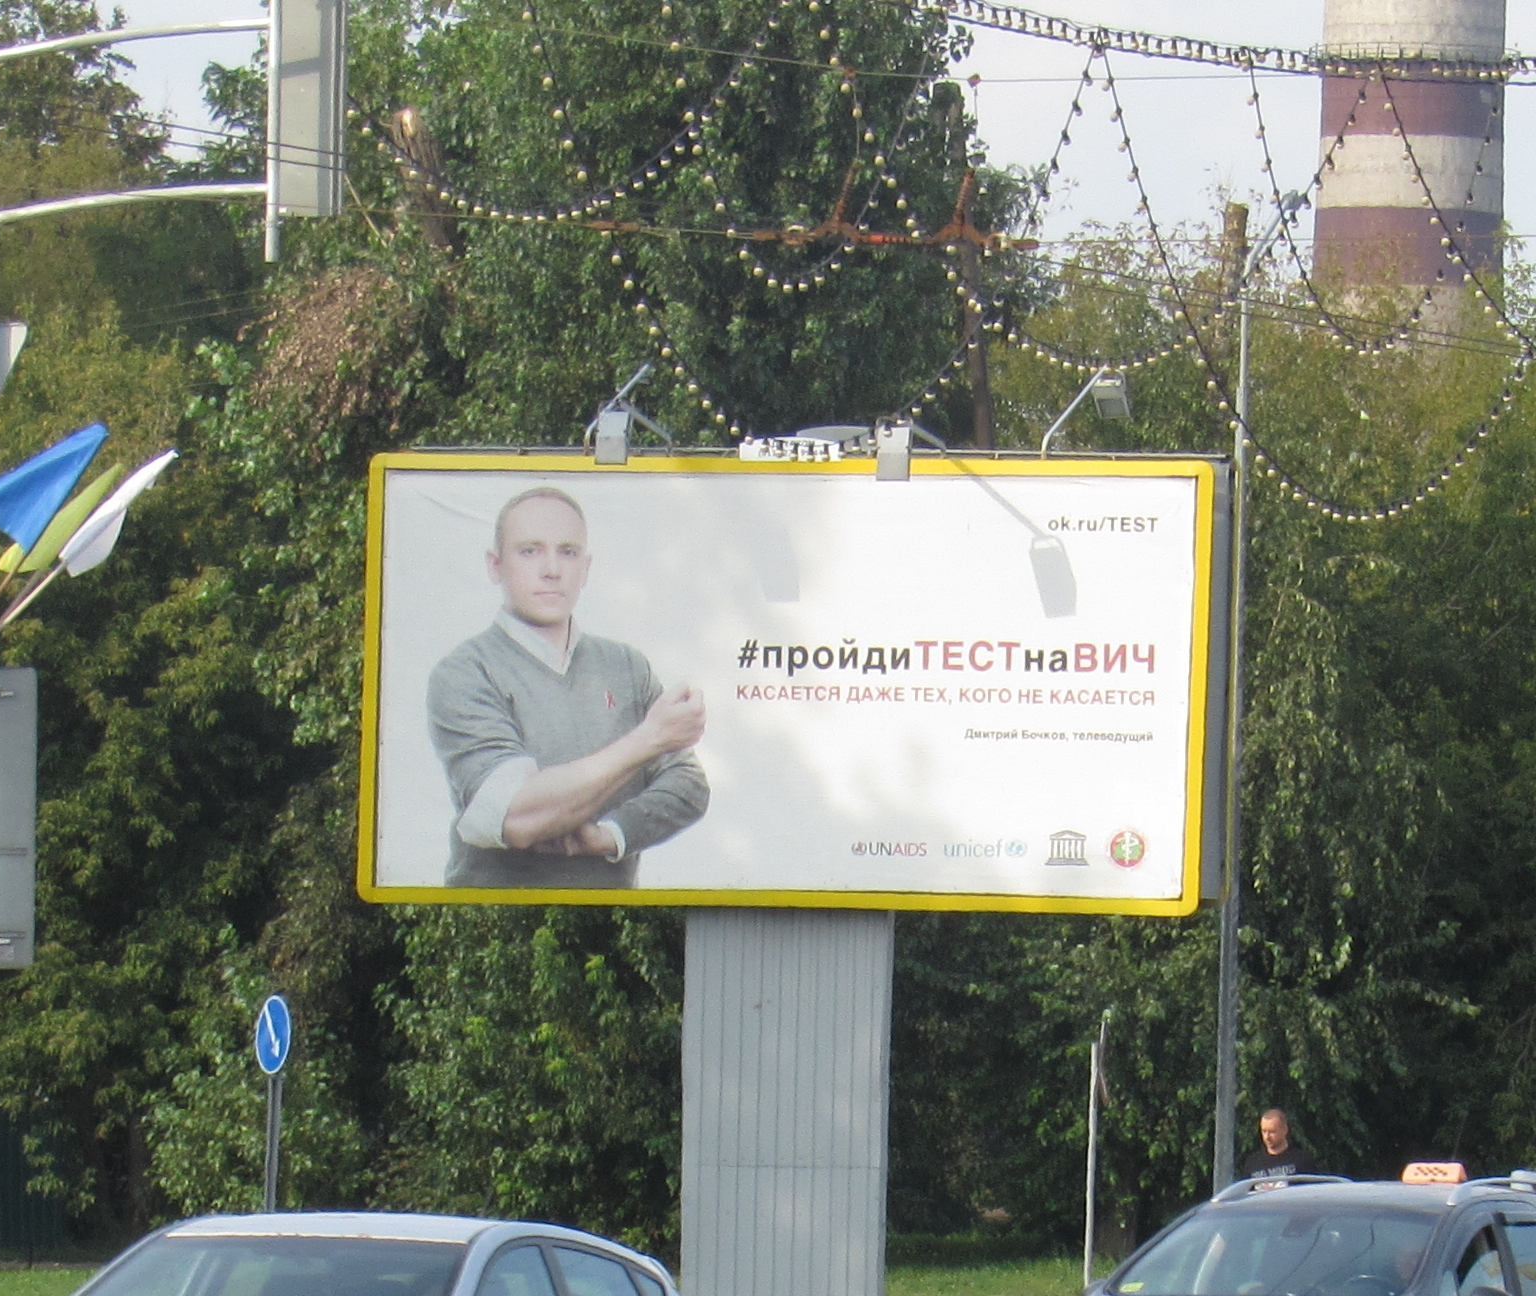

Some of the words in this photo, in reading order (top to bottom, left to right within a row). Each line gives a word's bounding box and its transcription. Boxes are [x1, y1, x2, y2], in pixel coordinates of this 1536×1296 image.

[1047, 515, 1160, 533] ok.ru/TEST
[737, 638, 1156, 677] #пройдиТЕСТнаВИЧ
[736, 684, 842, 702] КАСАЕТСЯ
[845, 686, 906, 705] ДАЖЕ
[911, 687, 953, 705] ТЕХ,
[959, 687, 1012, 704] КОГО
[1018, 688, 1044, 705] НЕ
[1050, 689, 1156, 706] КАСАЕТСЯ
[964, 728, 1018, 743] Дмитрий
[1021, 729, 1069, 743] Бочков,
[1072, 730, 1154, 744] телеведущий
[868, 841, 928, 857] UNAIDS
[943, 840, 1003, 858] unicef
